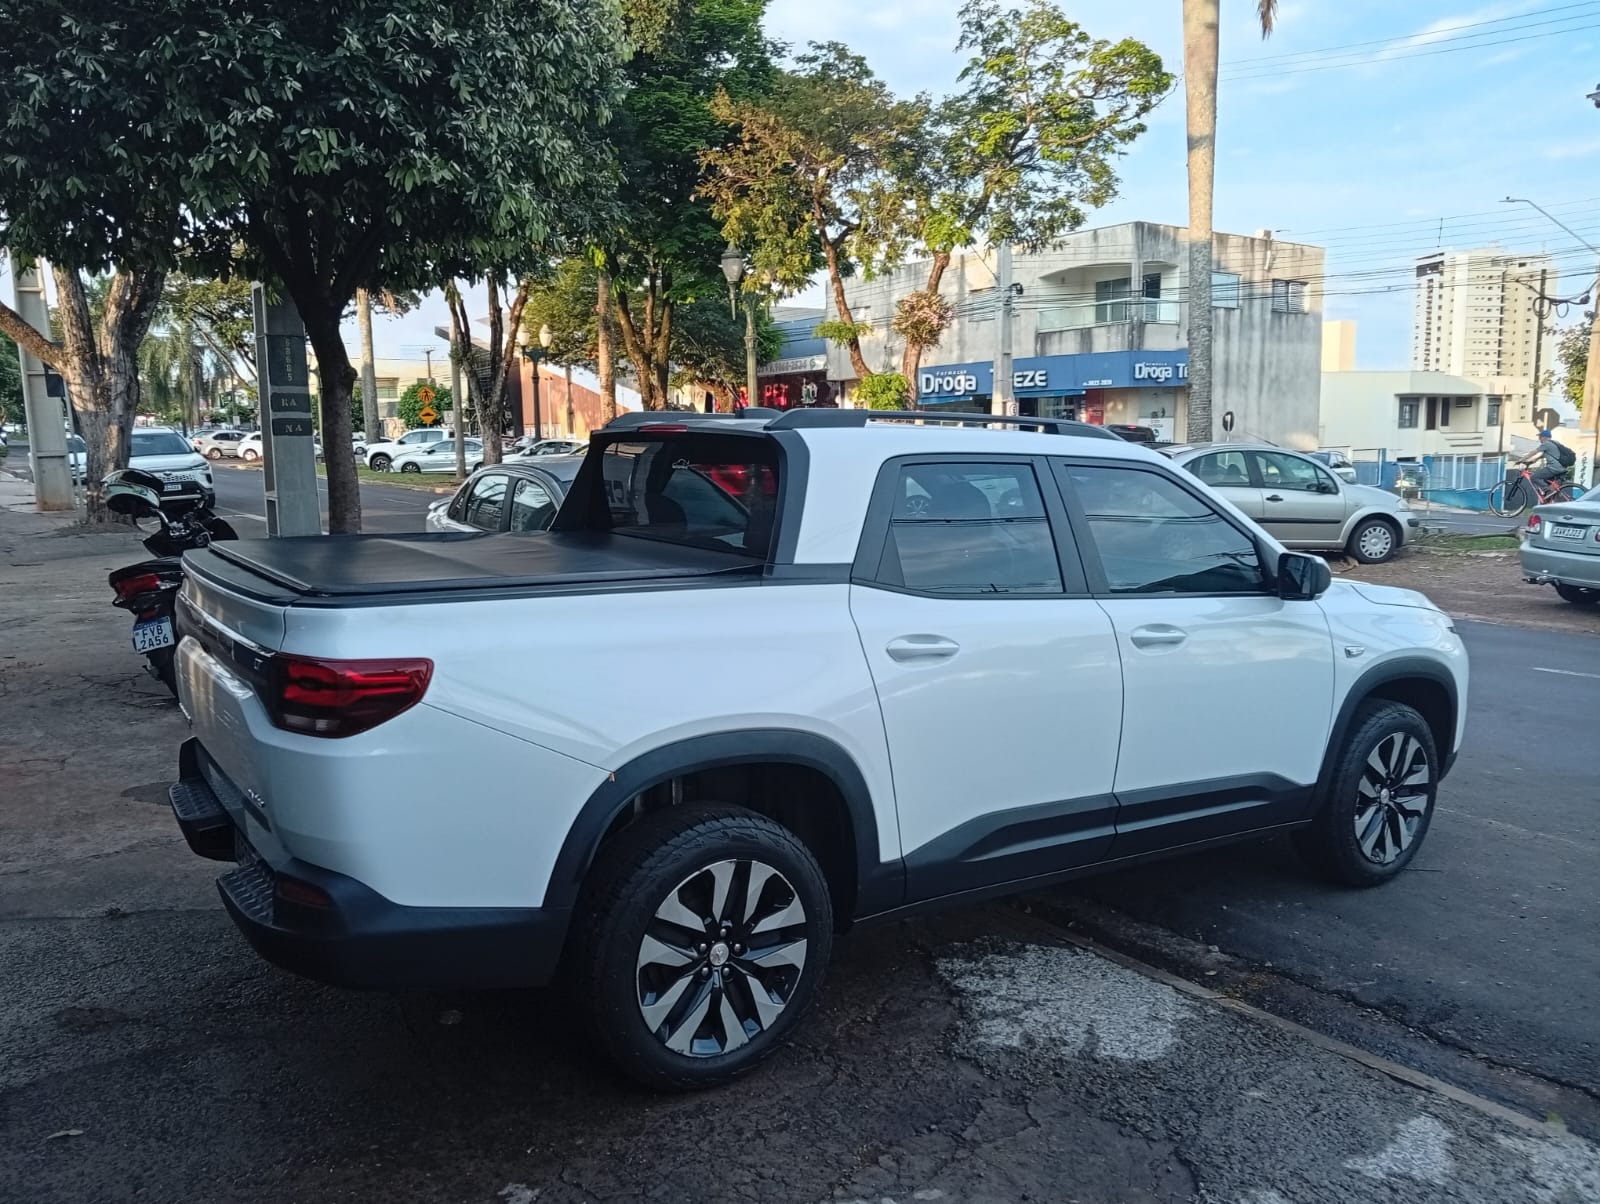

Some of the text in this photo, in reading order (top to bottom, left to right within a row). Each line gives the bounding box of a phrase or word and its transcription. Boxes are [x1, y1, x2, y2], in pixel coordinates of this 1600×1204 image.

[1134, 362, 1172, 382] Droga
[921, 373, 977, 396] Droga
[140, 633, 169, 649] 2A56
[142, 625, 163, 639] FYB
